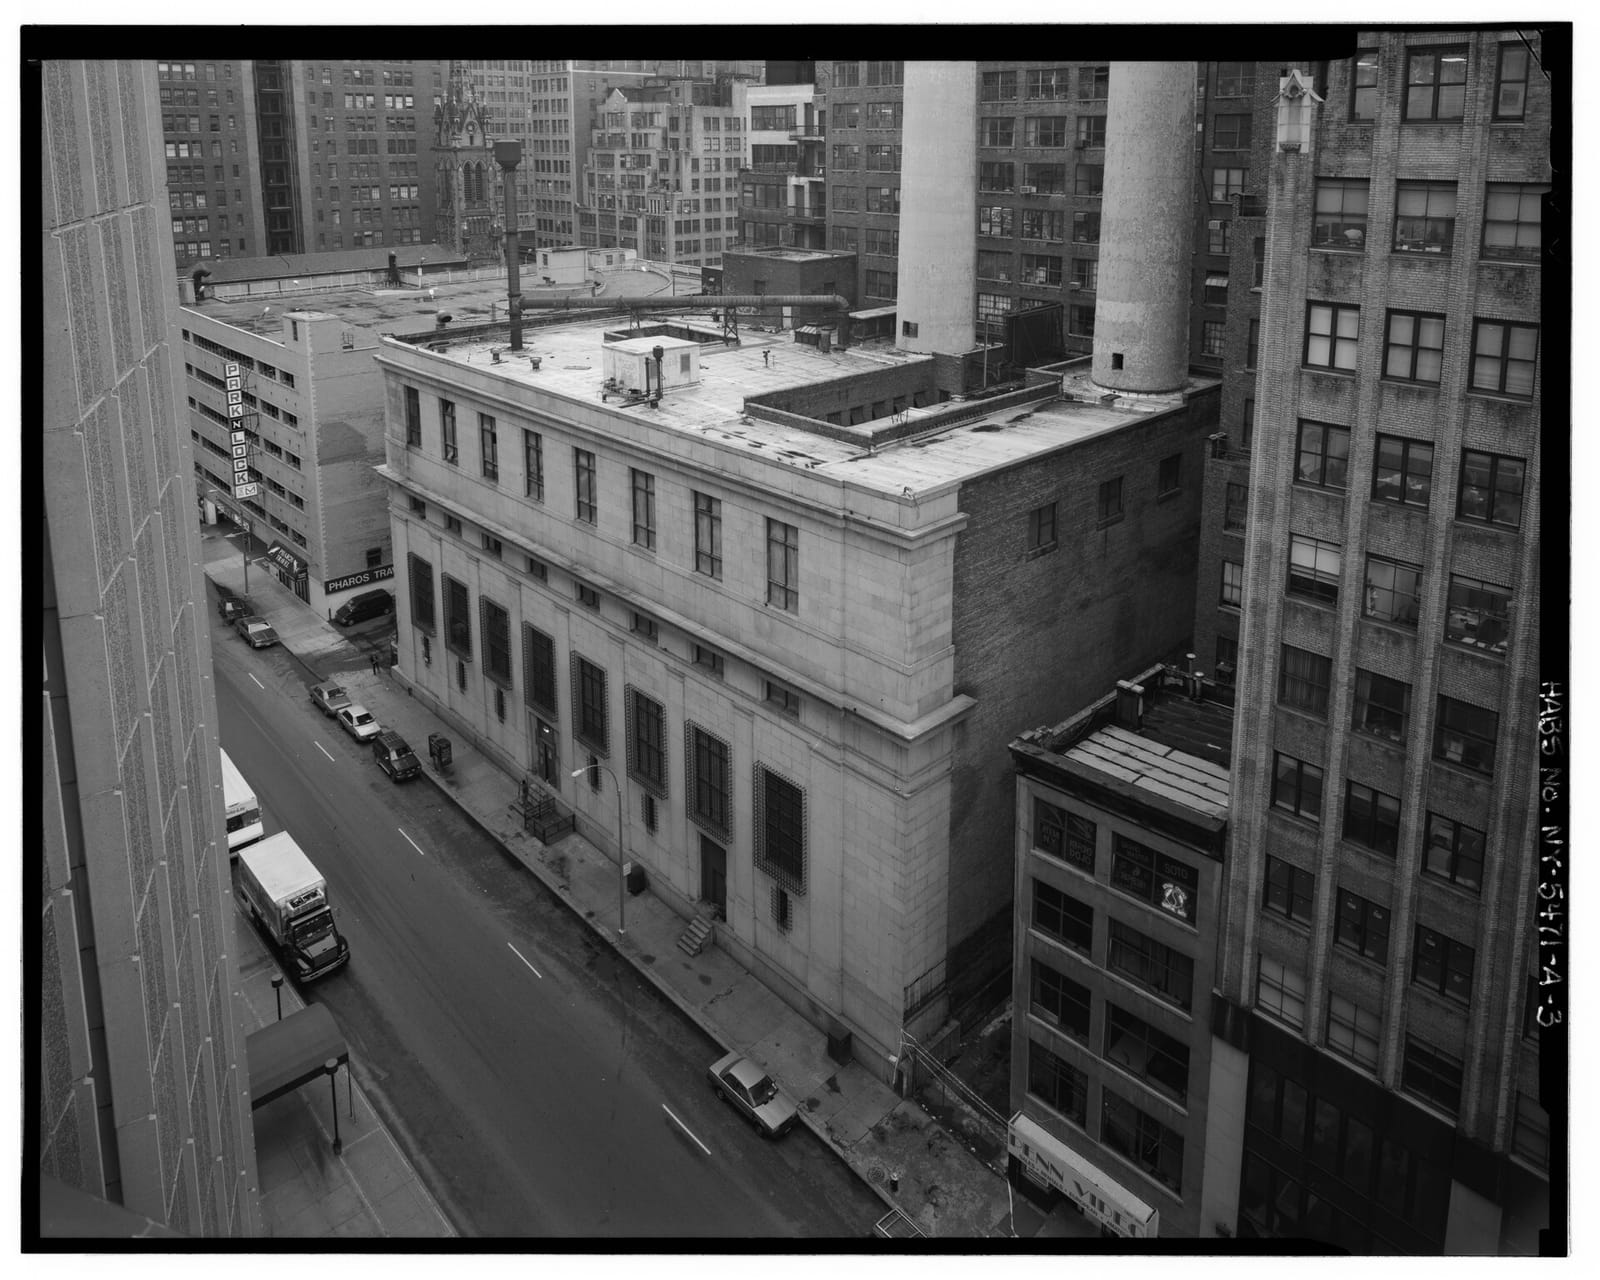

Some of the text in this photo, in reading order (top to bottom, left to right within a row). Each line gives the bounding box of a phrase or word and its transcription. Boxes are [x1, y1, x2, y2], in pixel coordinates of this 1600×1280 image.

[227, 364, 247, 483] PARK N LOCK
[328, 573, 370, 592] PHAROS
[1009, 1132, 1145, 1238] PENN VIDEO
